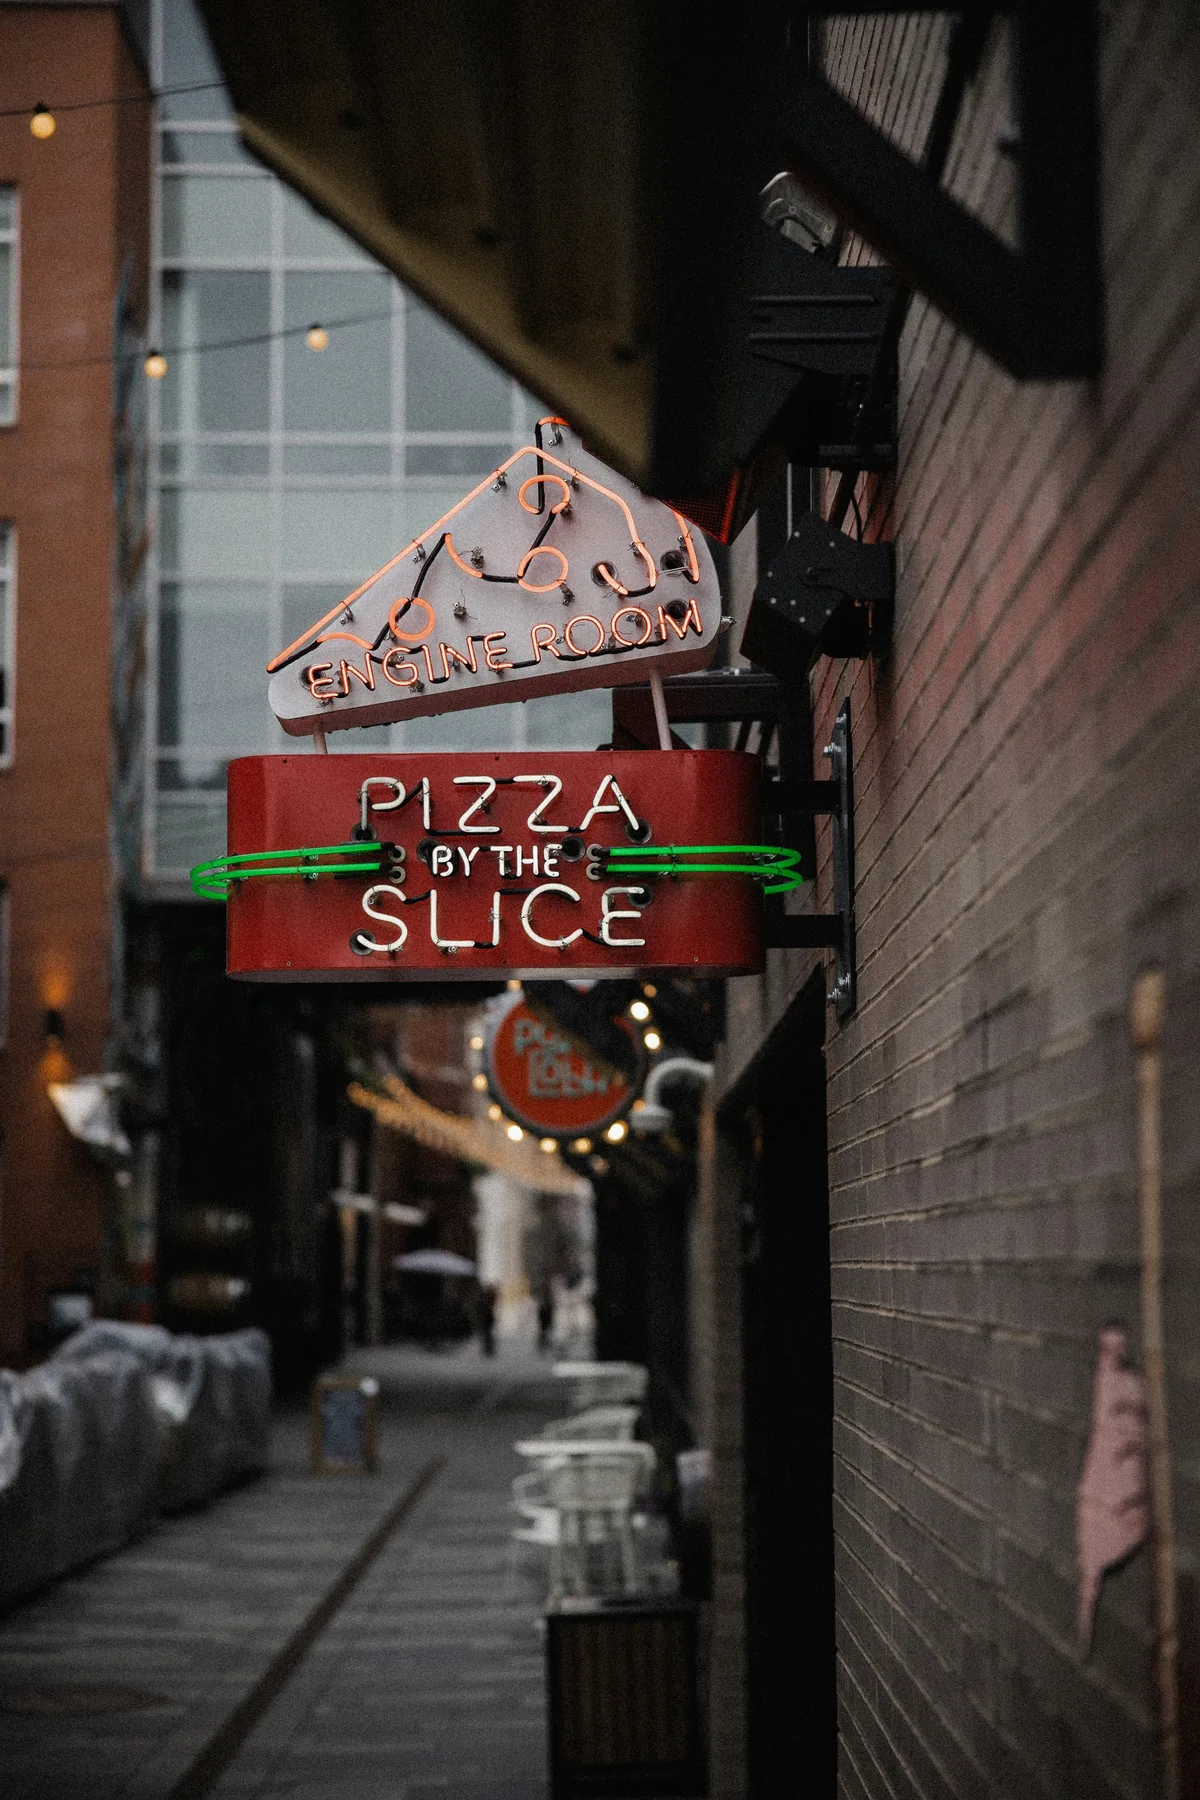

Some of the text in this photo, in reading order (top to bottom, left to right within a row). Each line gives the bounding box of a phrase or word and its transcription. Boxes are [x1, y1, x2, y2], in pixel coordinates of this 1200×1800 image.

[308, 599, 703, 700] ENGINE ROOM
[360, 774, 640, 833] PIZZA
[432, 844, 563, 877] BY THE
[356, 883, 646, 952] SLICE
